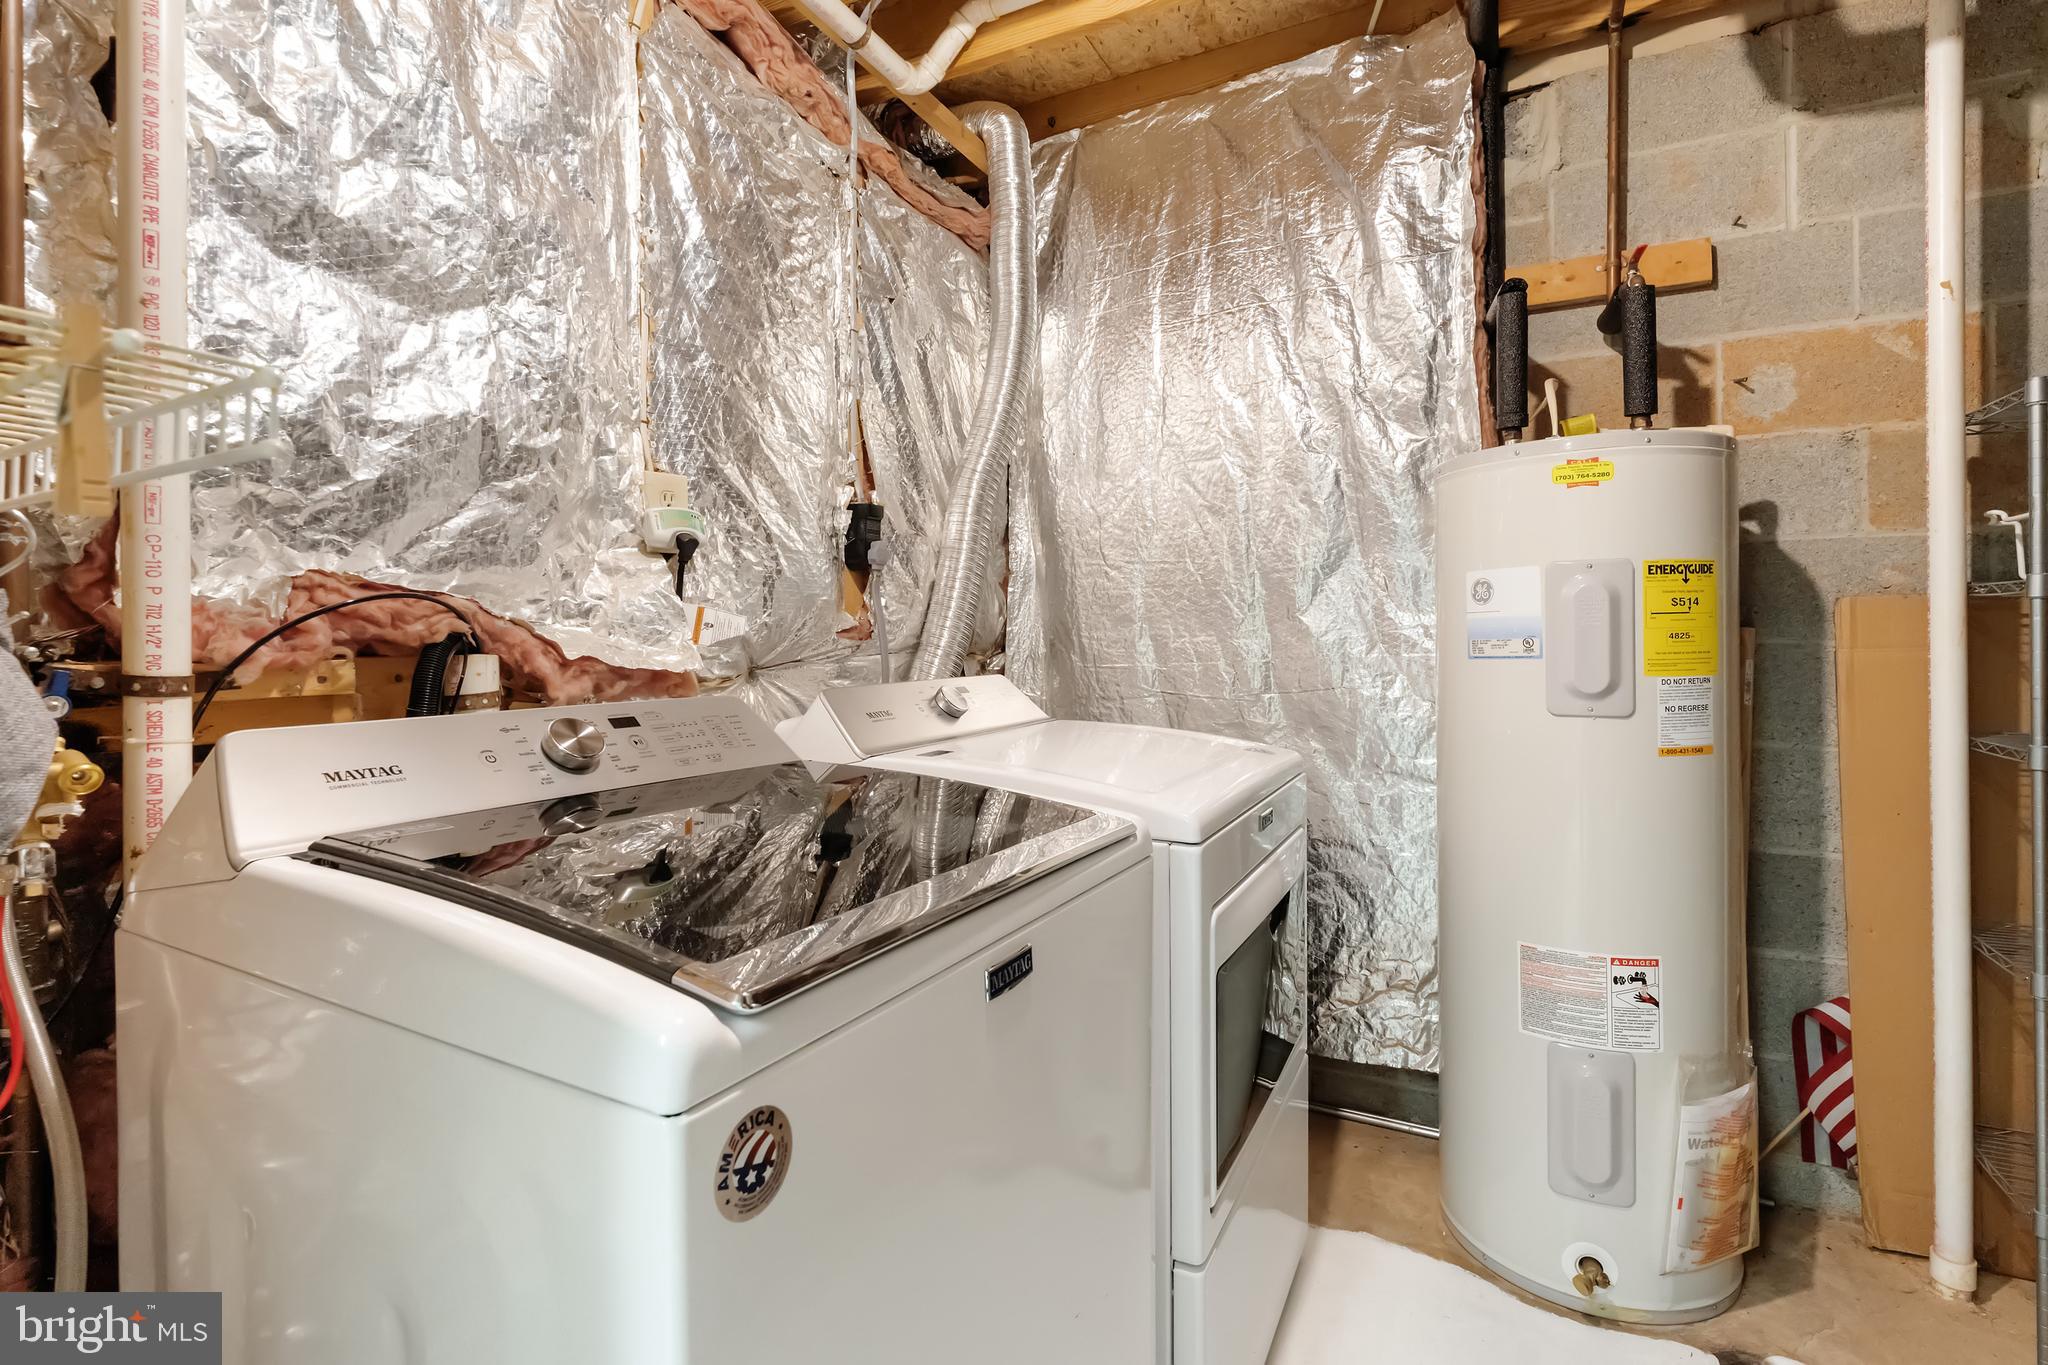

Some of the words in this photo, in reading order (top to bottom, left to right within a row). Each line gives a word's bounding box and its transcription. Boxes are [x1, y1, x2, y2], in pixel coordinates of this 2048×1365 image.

[142, 31, 160, 76] SCHEDULE
[142, 79, 160, 92] 40
[142, 93, 160, 122] ASTM
[142, 120, 160, 151] D-2665
[142, 153, 160, 202] CHARLOTTE
[142, 206, 160, 225] PIPE
[143, 292, 160, 311] PVC
[143, 314, 160, 331] 1120
[145, 534, 162, 578] CP-110
[1647, 563, 1714, 577] ENERGYGUIDE
[145, 586, 162, 595] P
[1668, 632, 1691, 640] 4825
[146, 654, 162, 671] PVC
[1661, 678, 1672, 686] DO
[1673, 678, 1686, 686] NOT
[1687, 677, 1711, 685] RETURN
[1677, 704, 1709, 712] REGRESE
[146, 757, 163, 768] 40
[322, 764, 403, 783] MAYTAG
[146, 773, 163, 796] ASTM
[146, 799, 163, 829] D-2665
[991, 954, 1032, 993] MAYTAG
